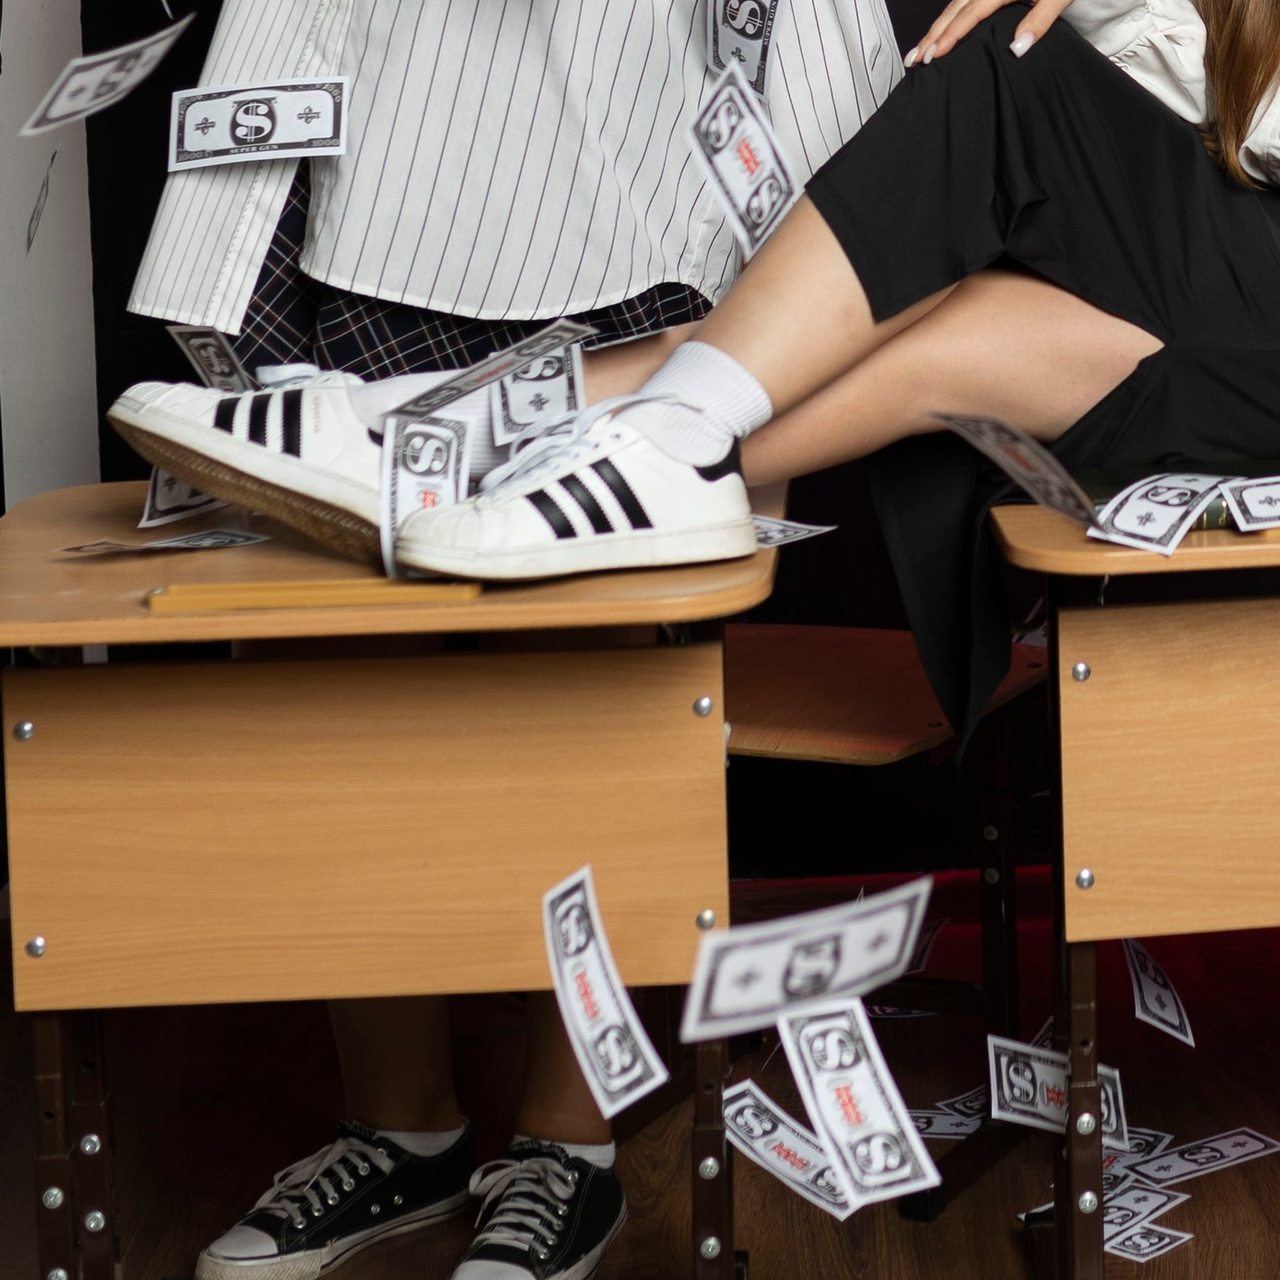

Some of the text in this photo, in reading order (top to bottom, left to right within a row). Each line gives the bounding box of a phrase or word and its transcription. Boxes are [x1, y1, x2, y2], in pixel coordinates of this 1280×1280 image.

[763, 0, 778, 46] SUPER GUN
[229, 145, 258, 154] SUPER
[258, 143, 279, 152] GUN
